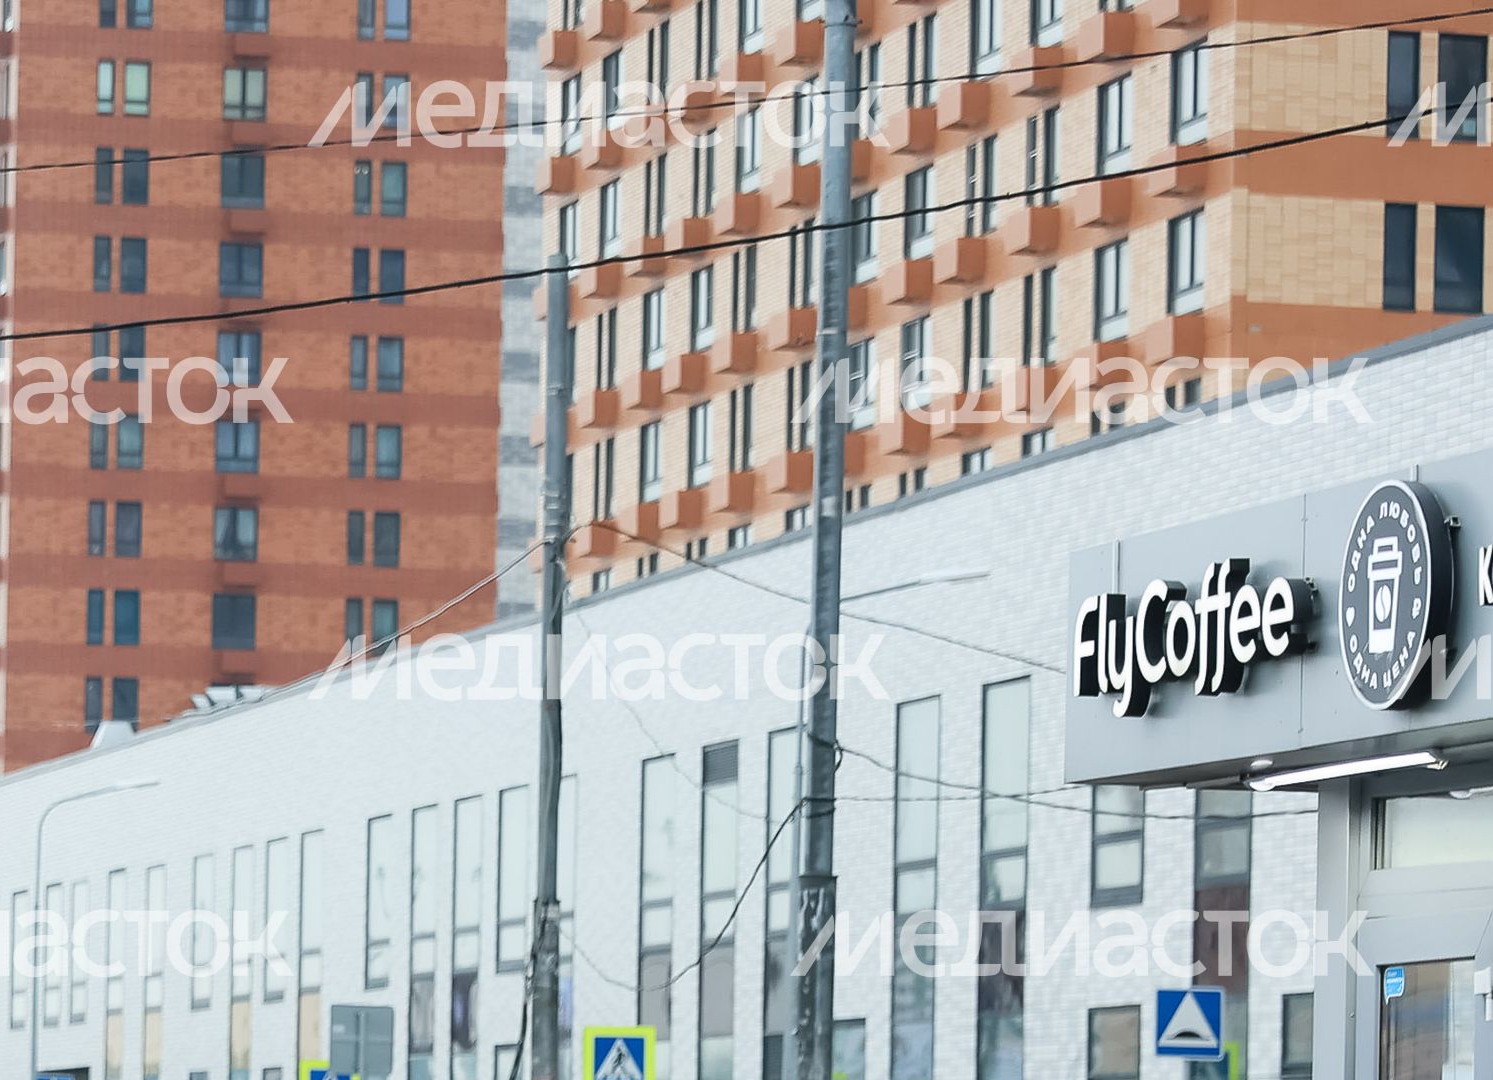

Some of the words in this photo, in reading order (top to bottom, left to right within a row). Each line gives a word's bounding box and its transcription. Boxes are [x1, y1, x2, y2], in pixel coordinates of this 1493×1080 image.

[1347, 515, 1375, 592] ОДНА
[1379, 500, 1423, 585] ЛЮБОВЬ
[1073, 557, 1296, 719] FlyCoffee
[1349, 634, 1378, 690] ОДНА
[1382, 630, 1416, 688] ЦЕНА
